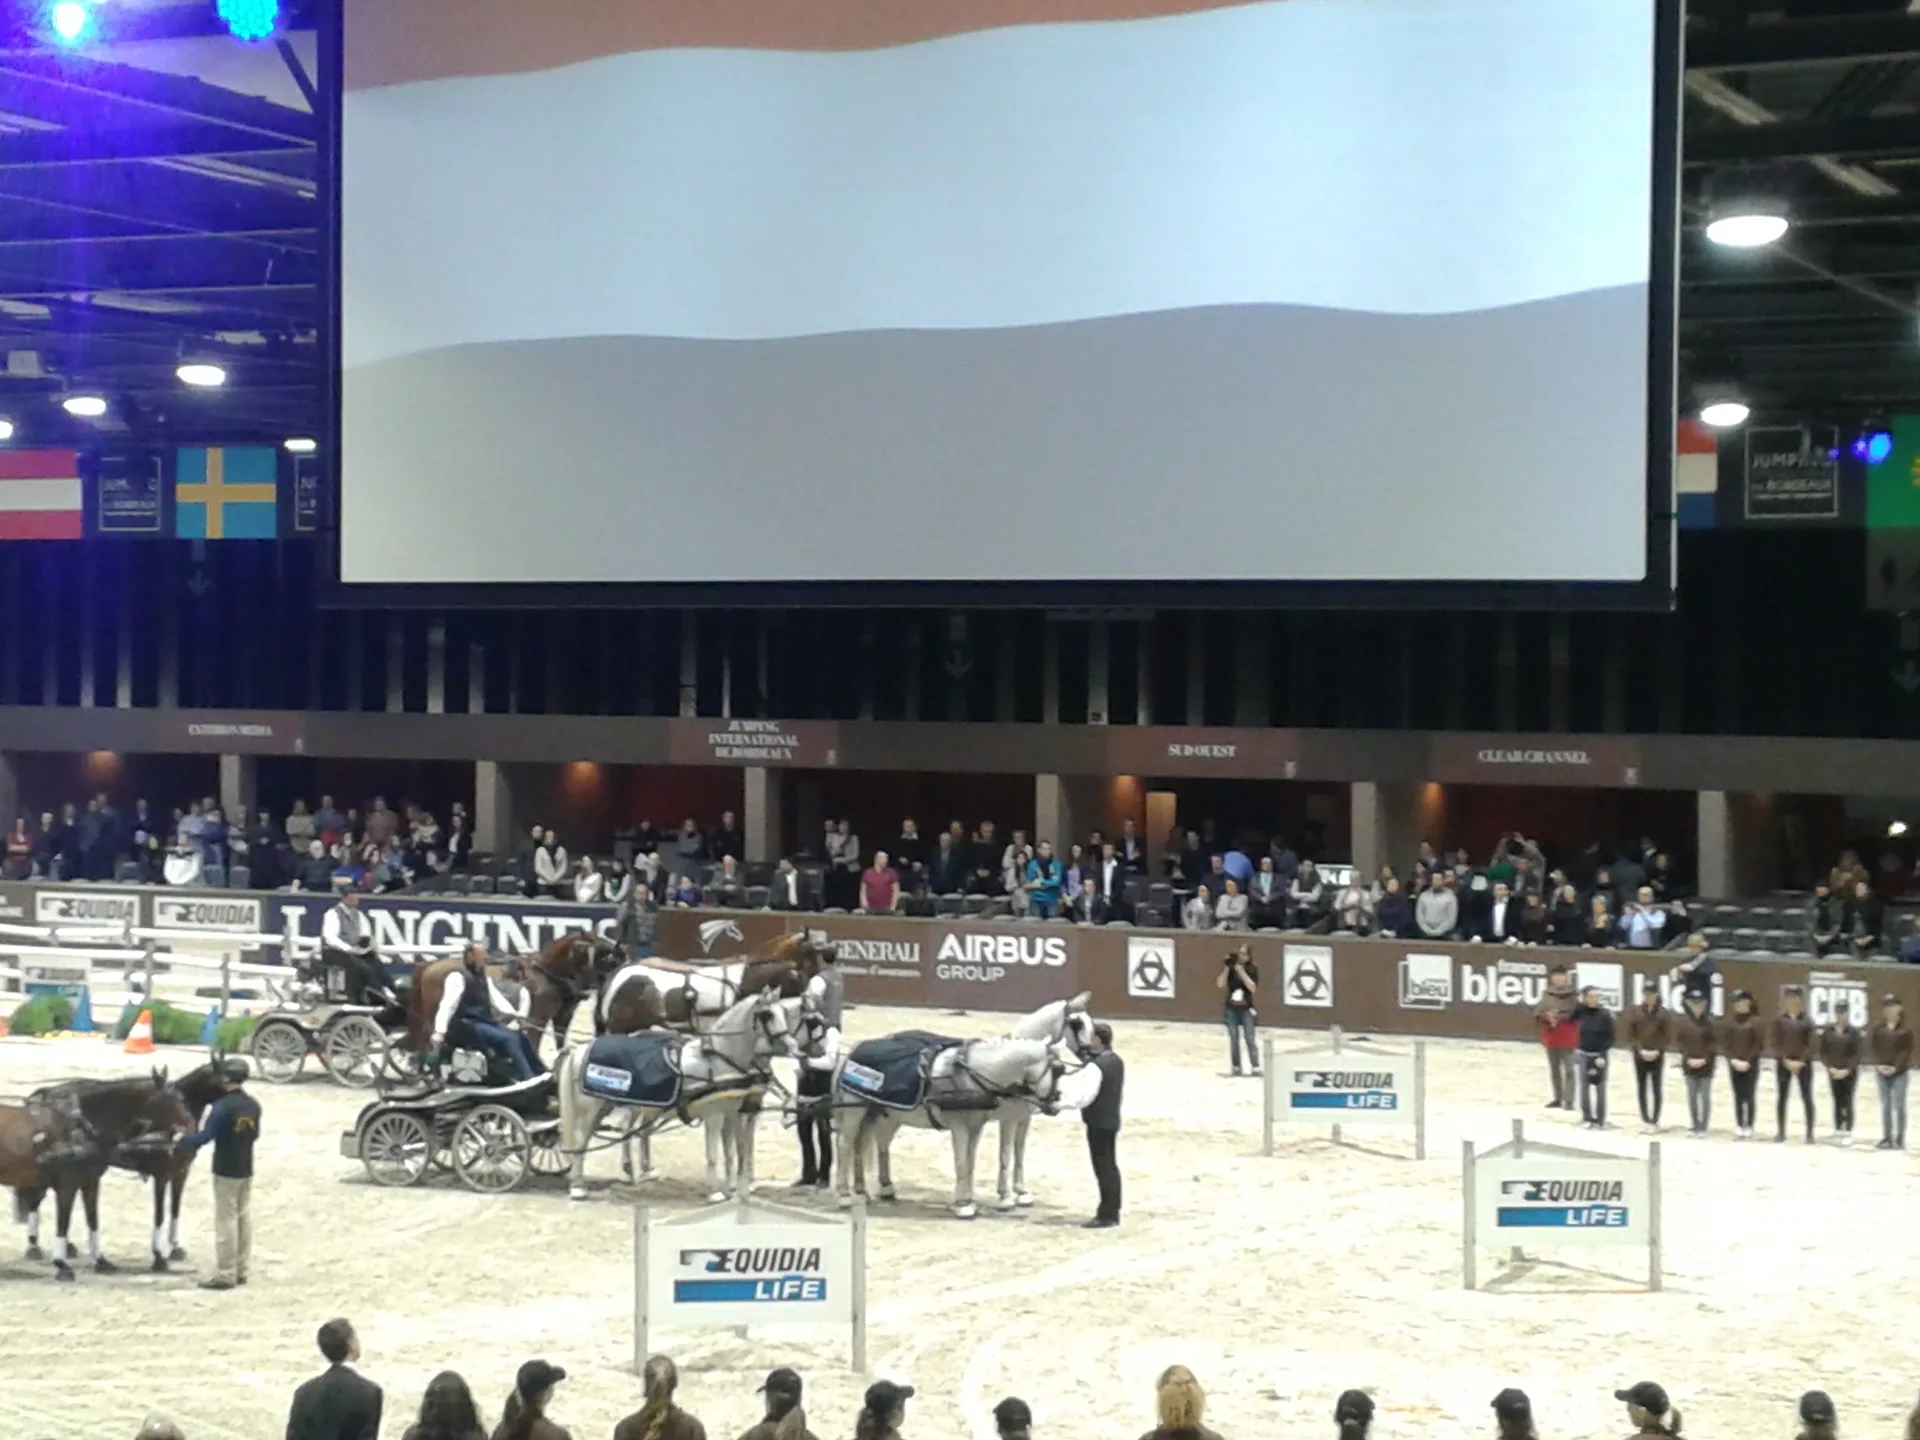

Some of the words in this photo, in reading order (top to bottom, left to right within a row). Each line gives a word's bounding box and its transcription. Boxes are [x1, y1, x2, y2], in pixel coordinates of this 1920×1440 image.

[186, 903, 255, 925] EQUIDIA
[936, 932, 1067, 967] AIRBUS
[936, 964, 1005, 982] GROUP
[1461, 964, 1547, 1006] bleu
[1322, 1071, 1393, 1088] EQUIDIA
[1346, 1095, 1394, 1108] LIFE
[1535, 1180, 1624, 1202] EQUIDIA
[1565, 1209, 1624, 1225] LIFE
[720, 1248, 822, 1273] EQUIDIA
[754, 1280, 821, 1300] LIFE
